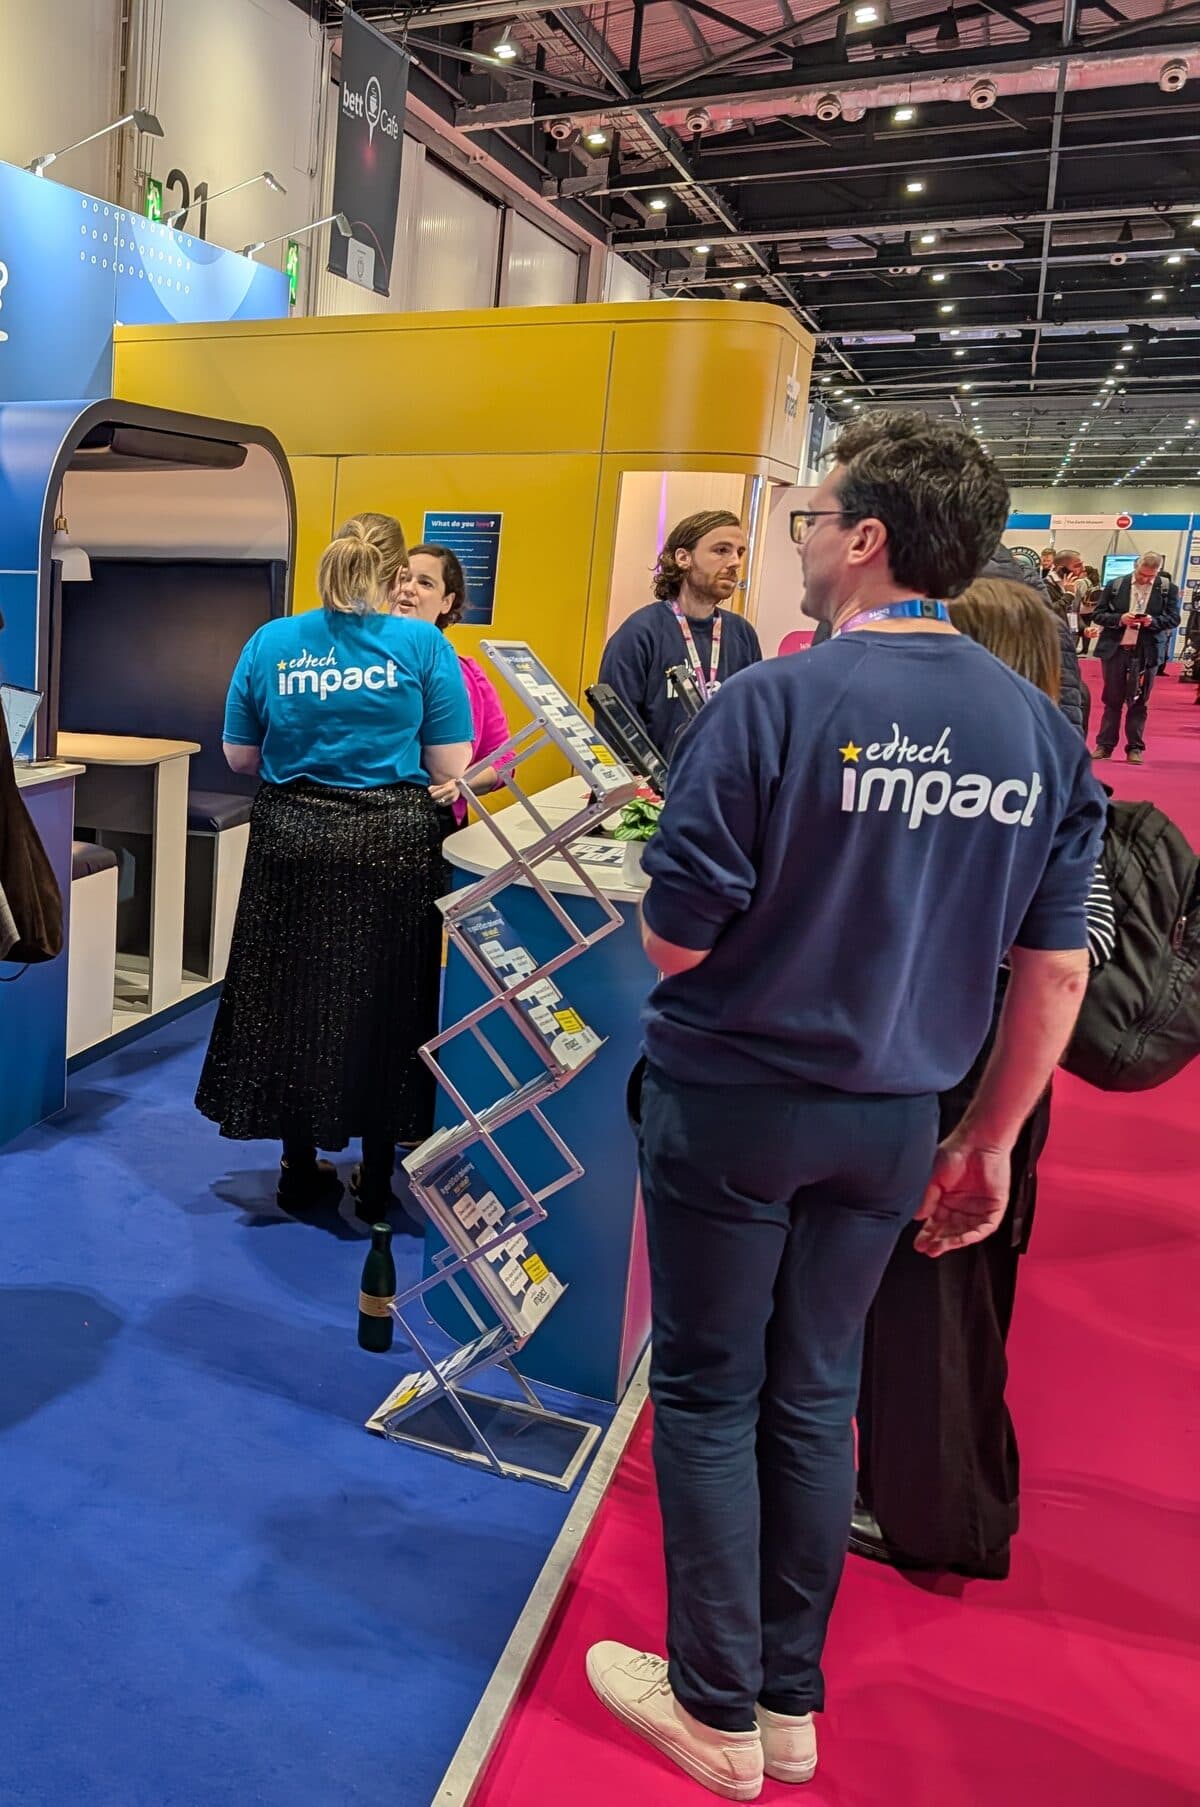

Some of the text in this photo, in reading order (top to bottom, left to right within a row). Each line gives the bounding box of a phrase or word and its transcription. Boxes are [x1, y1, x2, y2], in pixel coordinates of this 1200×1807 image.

[343, 82, 363, 118] bett
[166, 168, 208, 240] 21
[461, 521, 475, 529] you
[289, 647, 337, 668] edtech
[278, 659, 398, 700] impact
[866, 723, 951, 764] edtech
[842, 768, 1042, 829] impact
